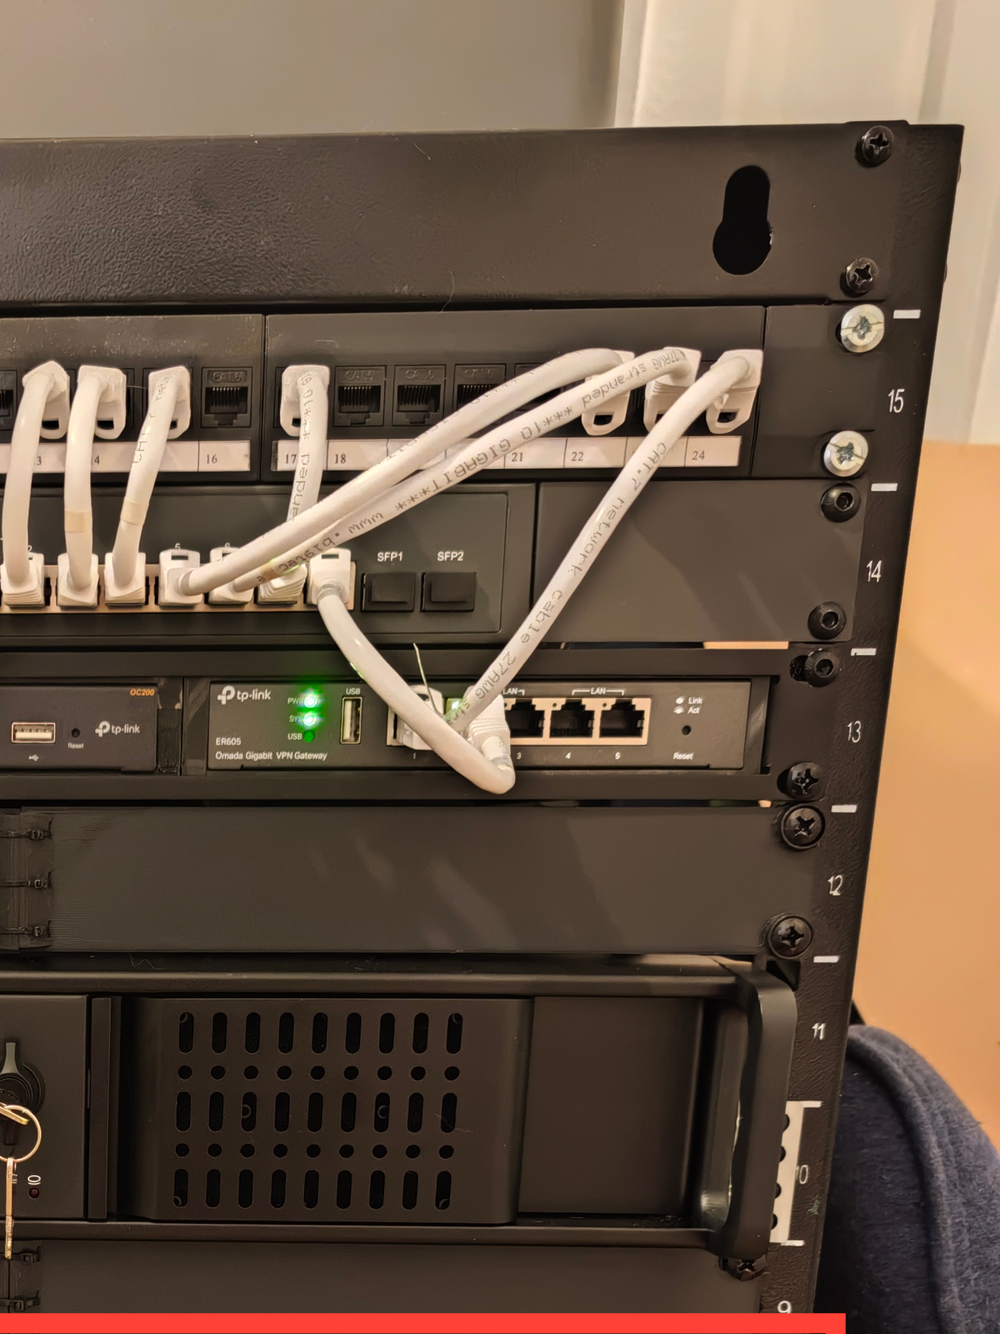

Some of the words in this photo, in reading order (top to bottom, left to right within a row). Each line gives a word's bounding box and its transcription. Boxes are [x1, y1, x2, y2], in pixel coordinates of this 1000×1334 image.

[582, 363, 647, 408] stranded
[887, 388, 905, 414] 15
[205, 454, 218, 464] 16
[285, 453, 297, 464] 17
[335, 453, 346, 464] 18
[511, 452, 523, 462] 21
[571, 451, 584, 462] 22
[692, 450, 705, 461] 24
[631, 442, 667, 492] CAT.7
[567, 497, 625, 576] network
[377, 551, 403, 562] SFP1
[437, 551, 464, 562] SFP2
[866, 560, 882, 583] 14
[520, 589, 563, 644] cable
[474, 651, 516, 700] 27AWG
[236, 688, 272, 702] tp-link
[590, 687, 607, 695] LAN
[688, 706, 700, 714] Act
[111, 723, 140, 735] tp-link
[846, 720, 862, 743] 13
[215, 737, 241, 745] ER605
[287, 732, 303, 740] USB
[215, 751, 243, 760] Omada
[245, 751, 273, 762] Gigabit
[276, 751, 293, 760] VPN
[294, 751, 328, 762] Gateway
[673, 752, 694, 760] Reset
[827, 874, 844, 896] 12
[811, 1022, 826, 1040] 11
